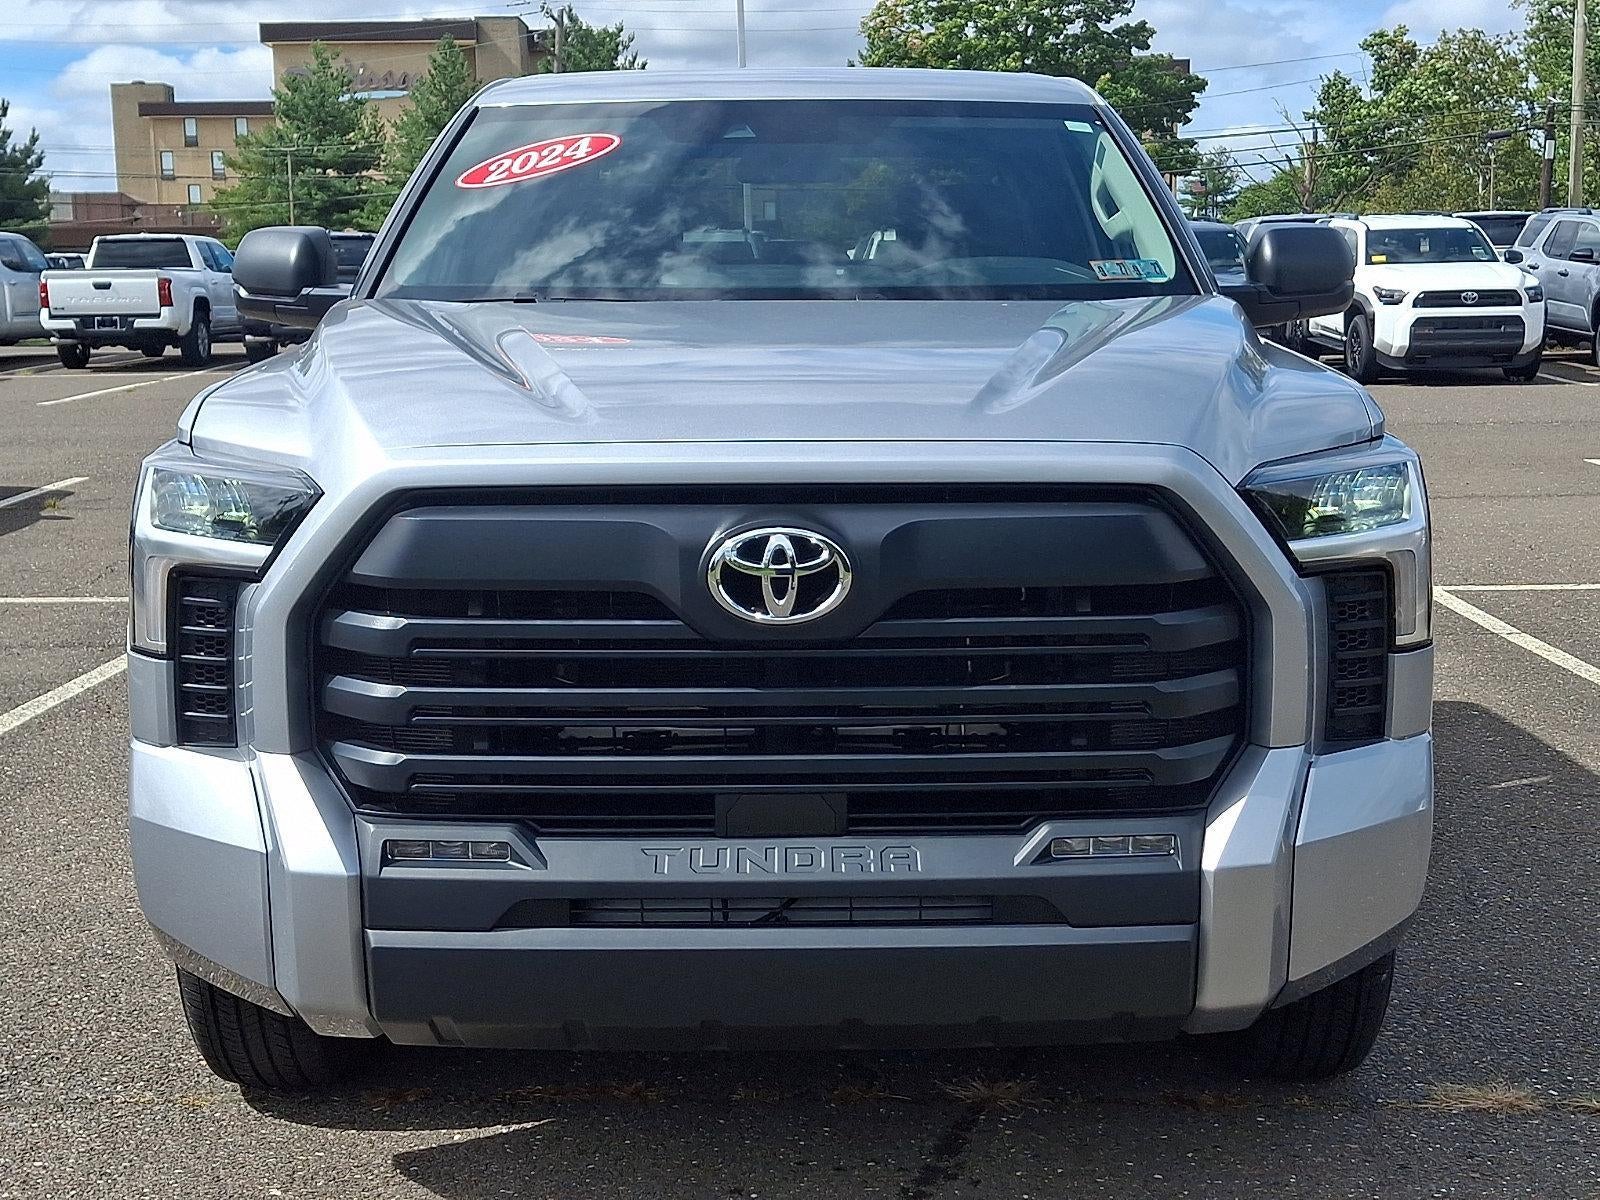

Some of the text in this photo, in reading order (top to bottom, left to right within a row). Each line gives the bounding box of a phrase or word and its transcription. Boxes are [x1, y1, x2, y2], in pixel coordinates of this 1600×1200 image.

[484, 137, 592, 183] 2024
[66, 296, 143, 304] TACOMA
[641, 845, 923, 874] TUNDRA
